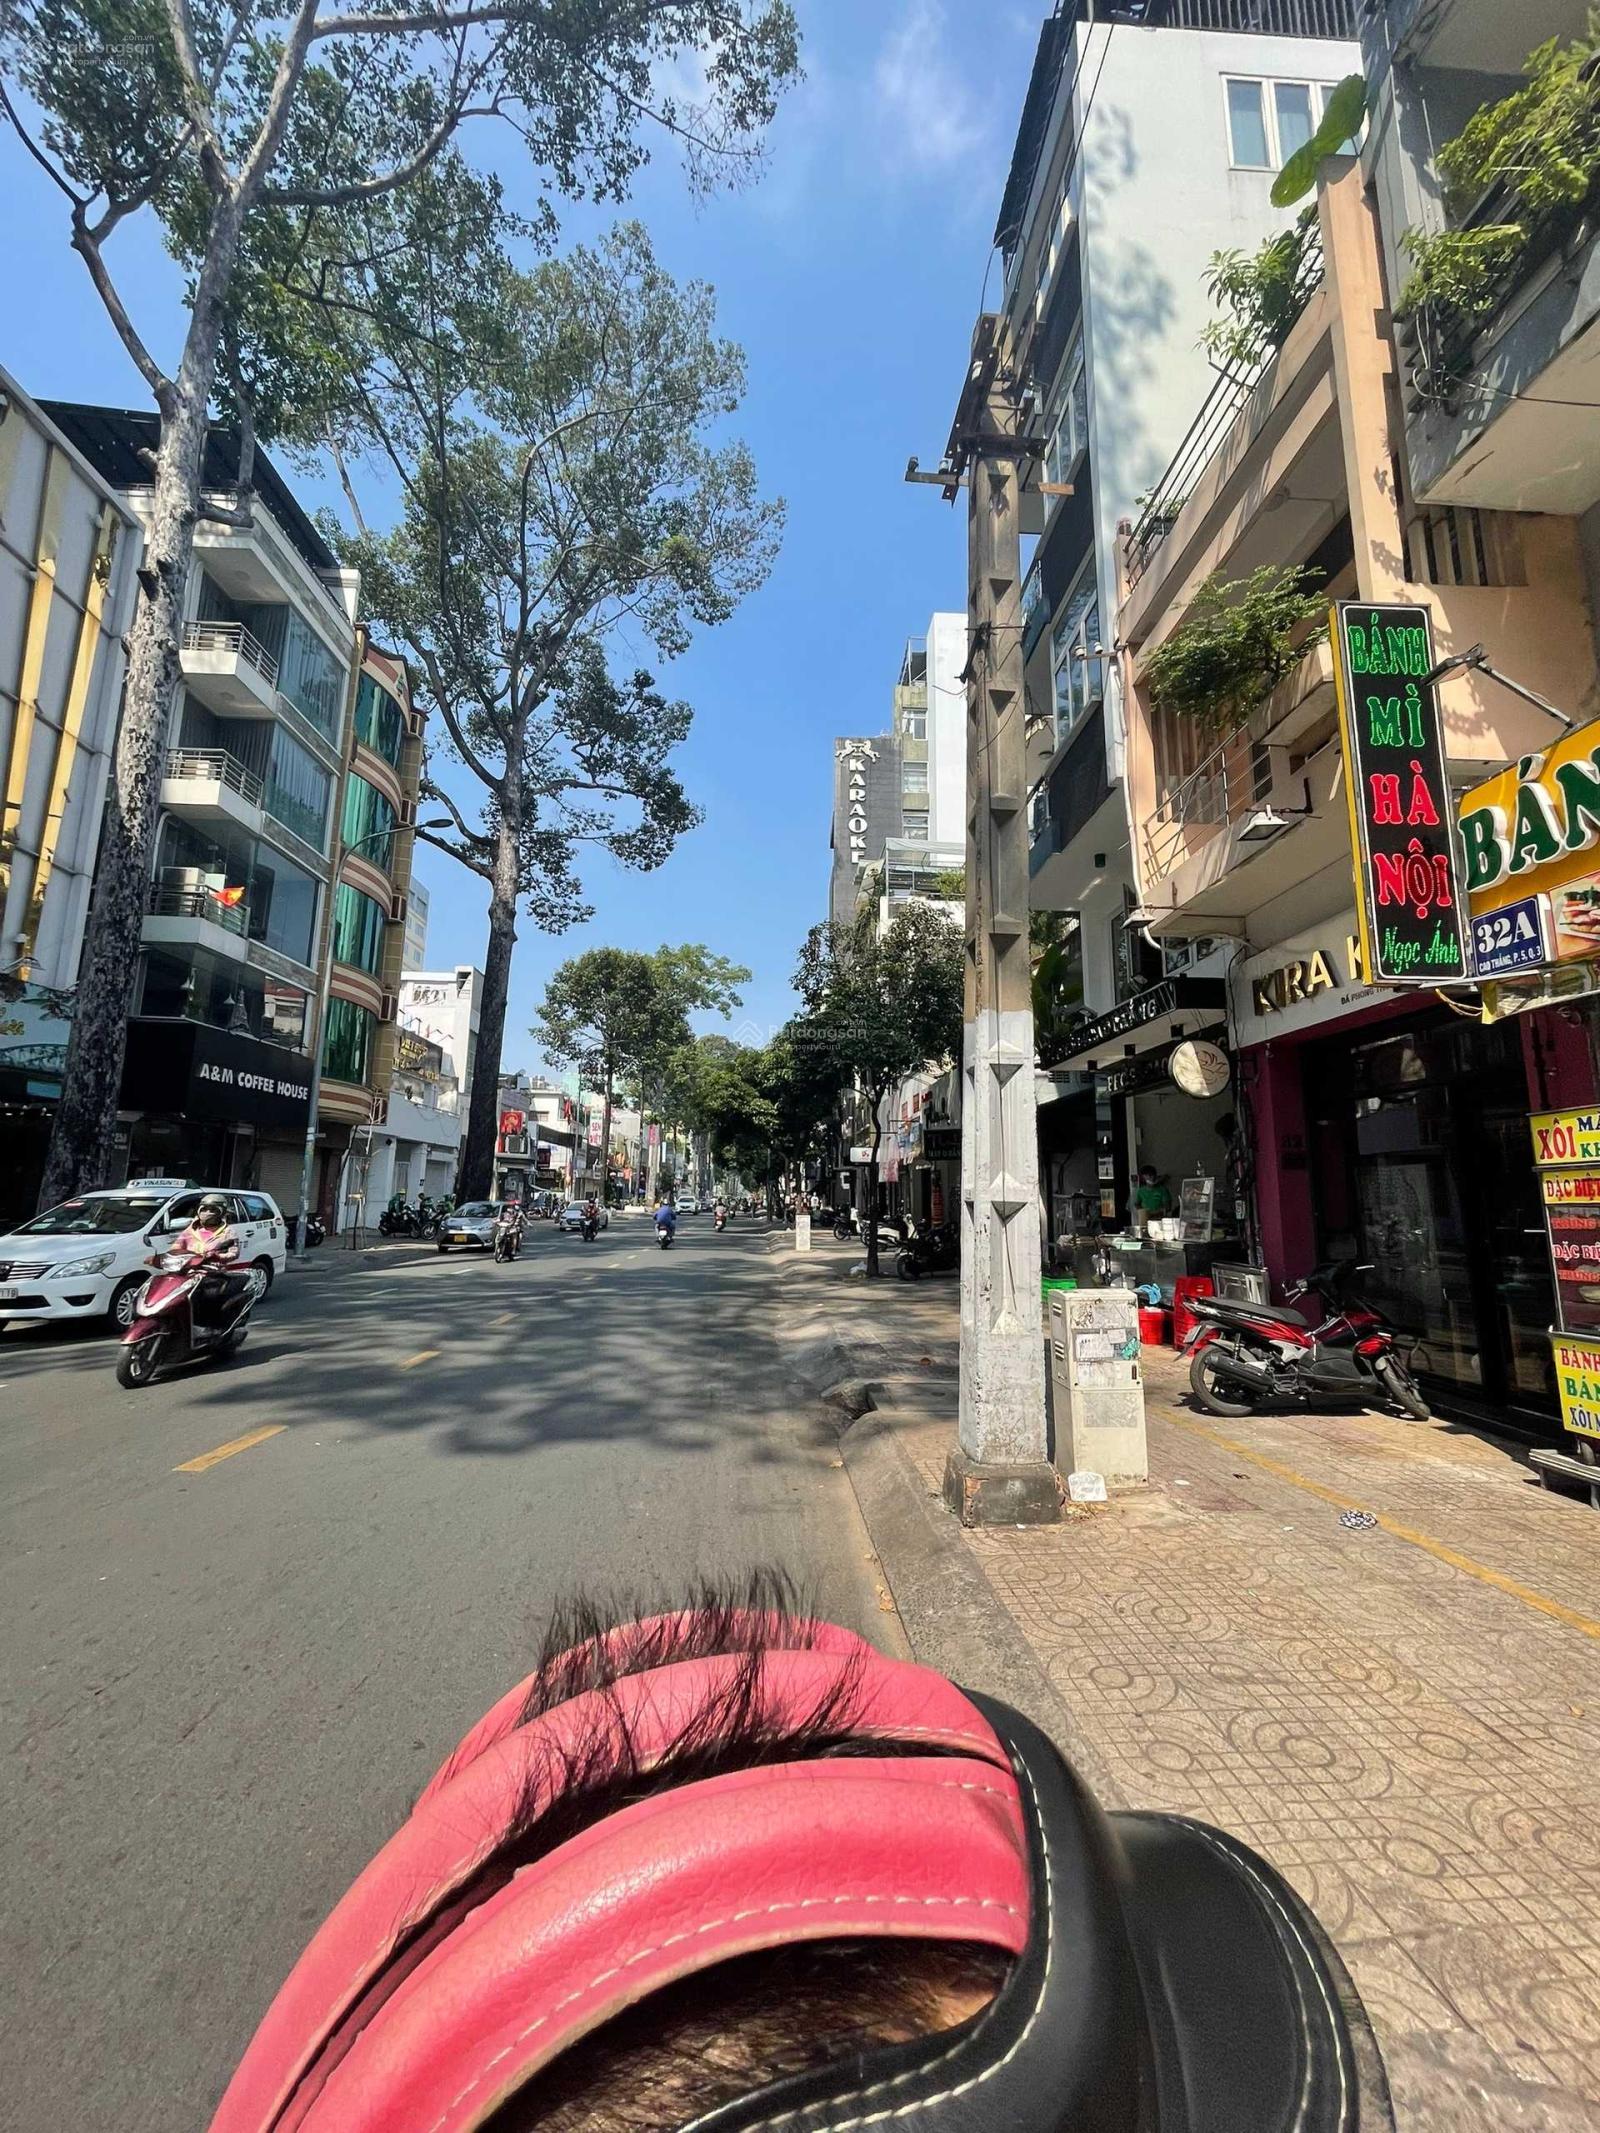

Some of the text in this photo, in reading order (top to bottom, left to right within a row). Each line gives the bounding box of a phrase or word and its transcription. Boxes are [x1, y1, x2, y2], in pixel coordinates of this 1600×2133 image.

[1348, 612, 1429, 675] BÁNH
[1367, 683, 1425, 747] MÌ
[1370, 760, 1440, 825] HÀ
[1373, 838, 1453, 919] NỘI
[1381, 919, 1460, 974] Ngọc Ánh
[1477, 911, 1537, 953] 32A
[1252, 950, 1339, 1016] KIRA
[200, 1063, 309, 1100] A&M COFFEE HOUSE
[1537, 1117, 1577, 1160] XÔI
[1546, 1175, 1572, 1201] ĐẶC
